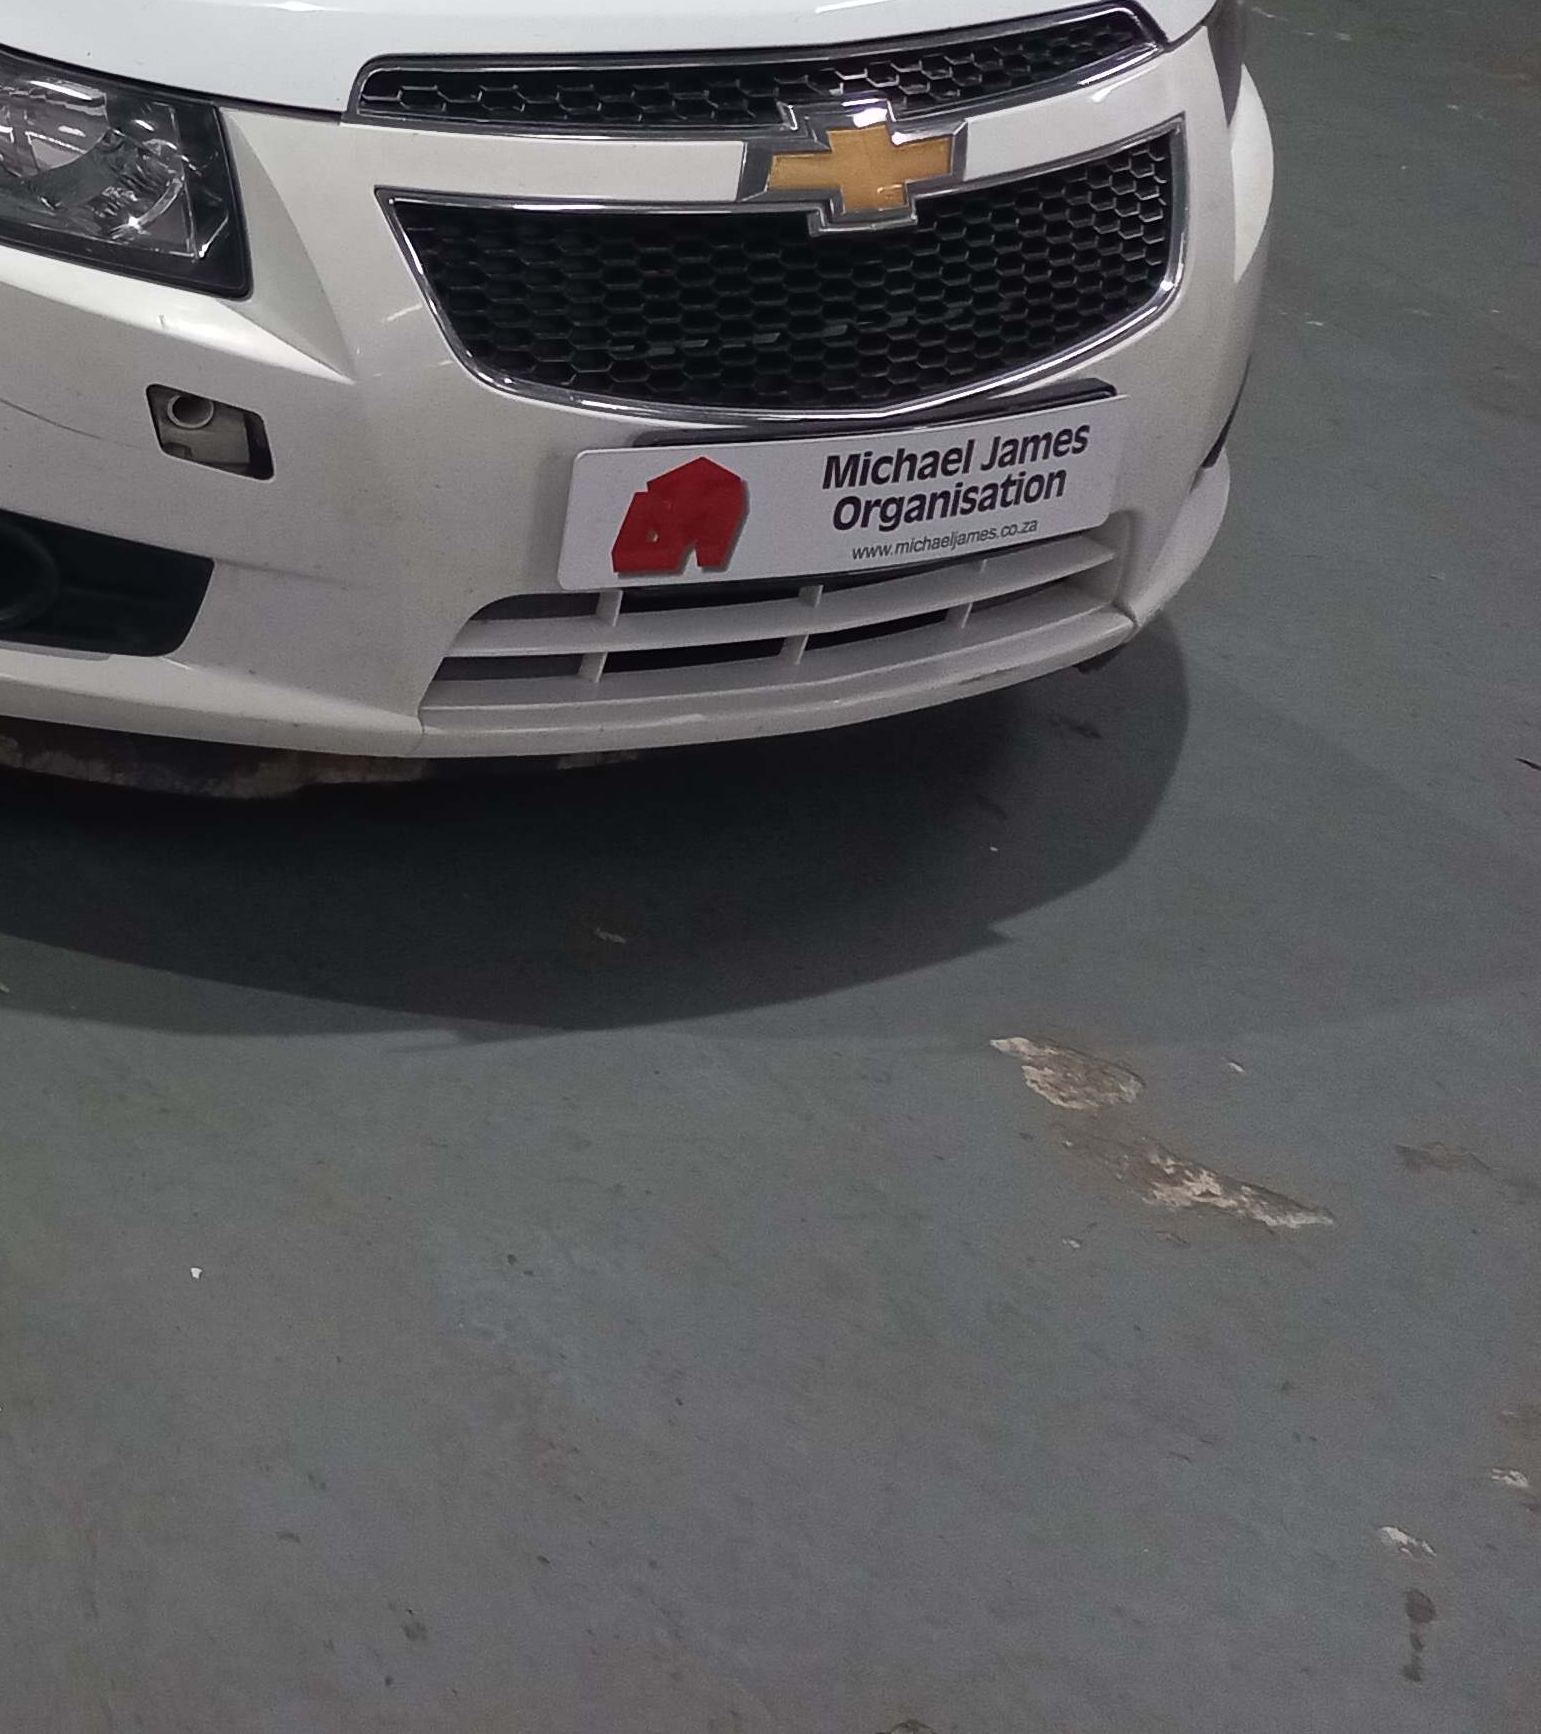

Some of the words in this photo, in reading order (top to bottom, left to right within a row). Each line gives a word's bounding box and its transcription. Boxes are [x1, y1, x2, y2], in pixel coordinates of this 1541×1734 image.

[822, 439, 976, 490] Michael
[980, 425, 1091, 472] James
[832, 469, 1067, 532] Organisation
[852, 519, 1038, 560] www.michaeljames.co.za
